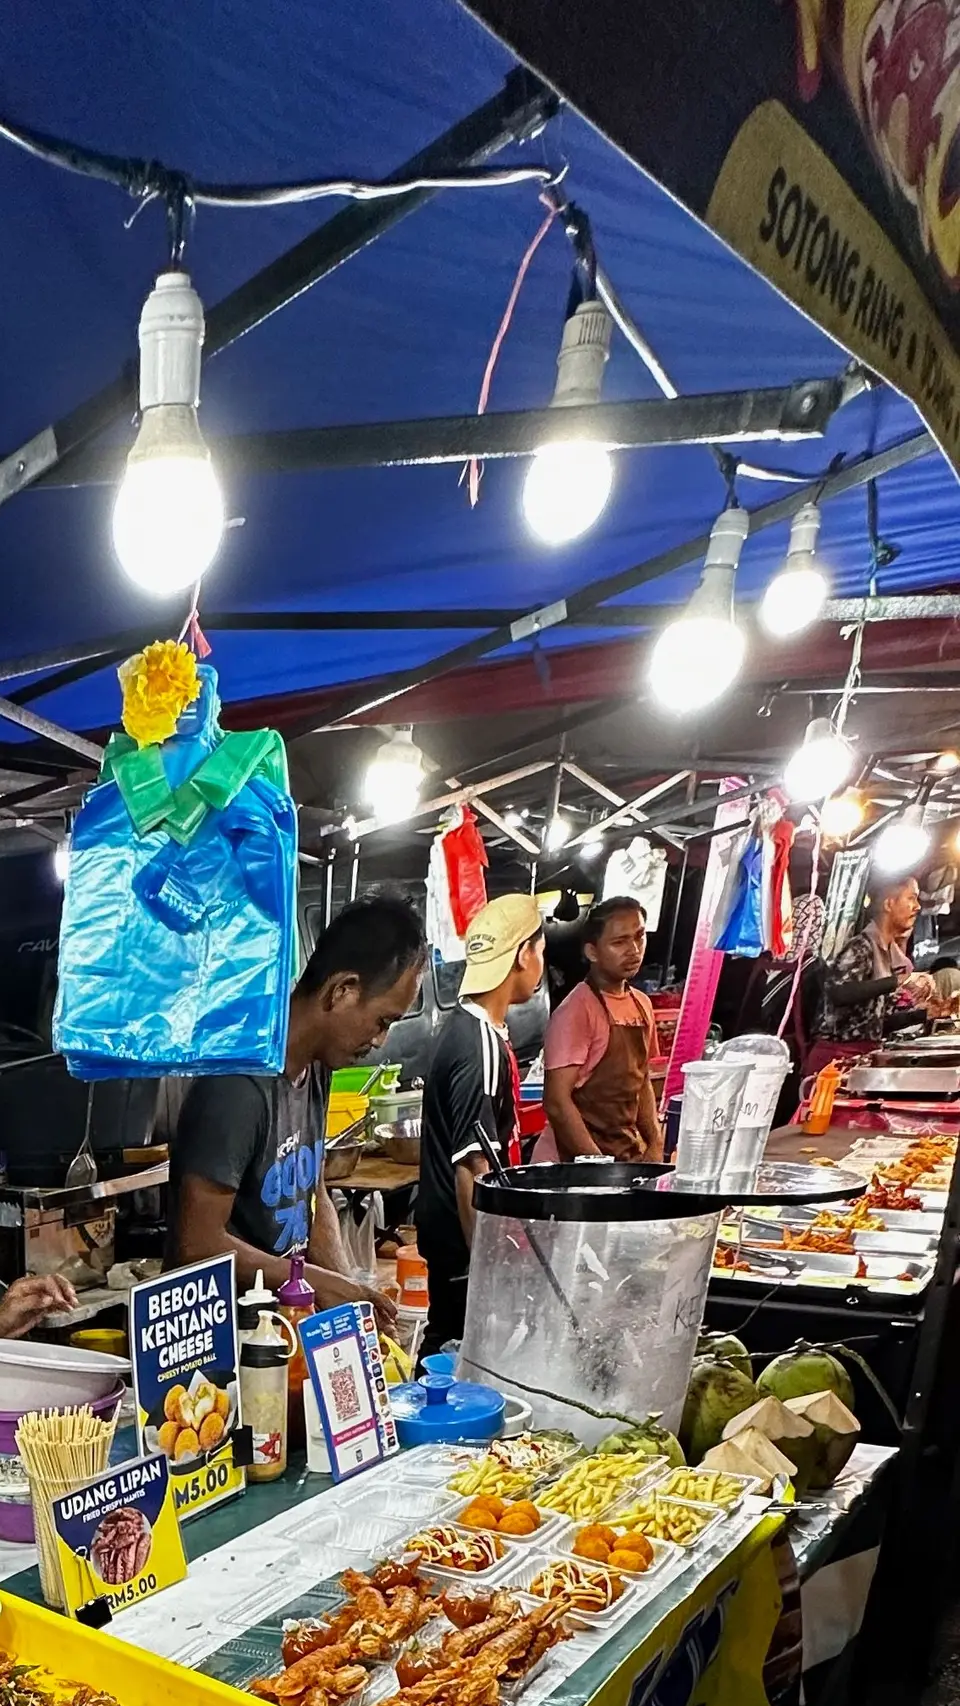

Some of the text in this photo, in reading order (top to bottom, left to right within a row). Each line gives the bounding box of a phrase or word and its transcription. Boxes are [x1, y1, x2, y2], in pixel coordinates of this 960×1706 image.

[759, 166, 906, 360] SOTONG RING
[148, 1274, 220, 1321] BEBOLA
[141, 1299, 227, 1352] KENTANG
[157, 1353, 217, 1383] CHEESY POTATO BALL
[158, 1331, 214, 1368] CHEESE
[60, 1460, 162, 1520] UDANG LIPAN
[83, 1508, 101, 1523] FRIED
[101, 1497, 123, 1515] CRISPY
[173, 1463, 230, 1510] M5.00
[107, 1573, 157, 1610] RM5.00
